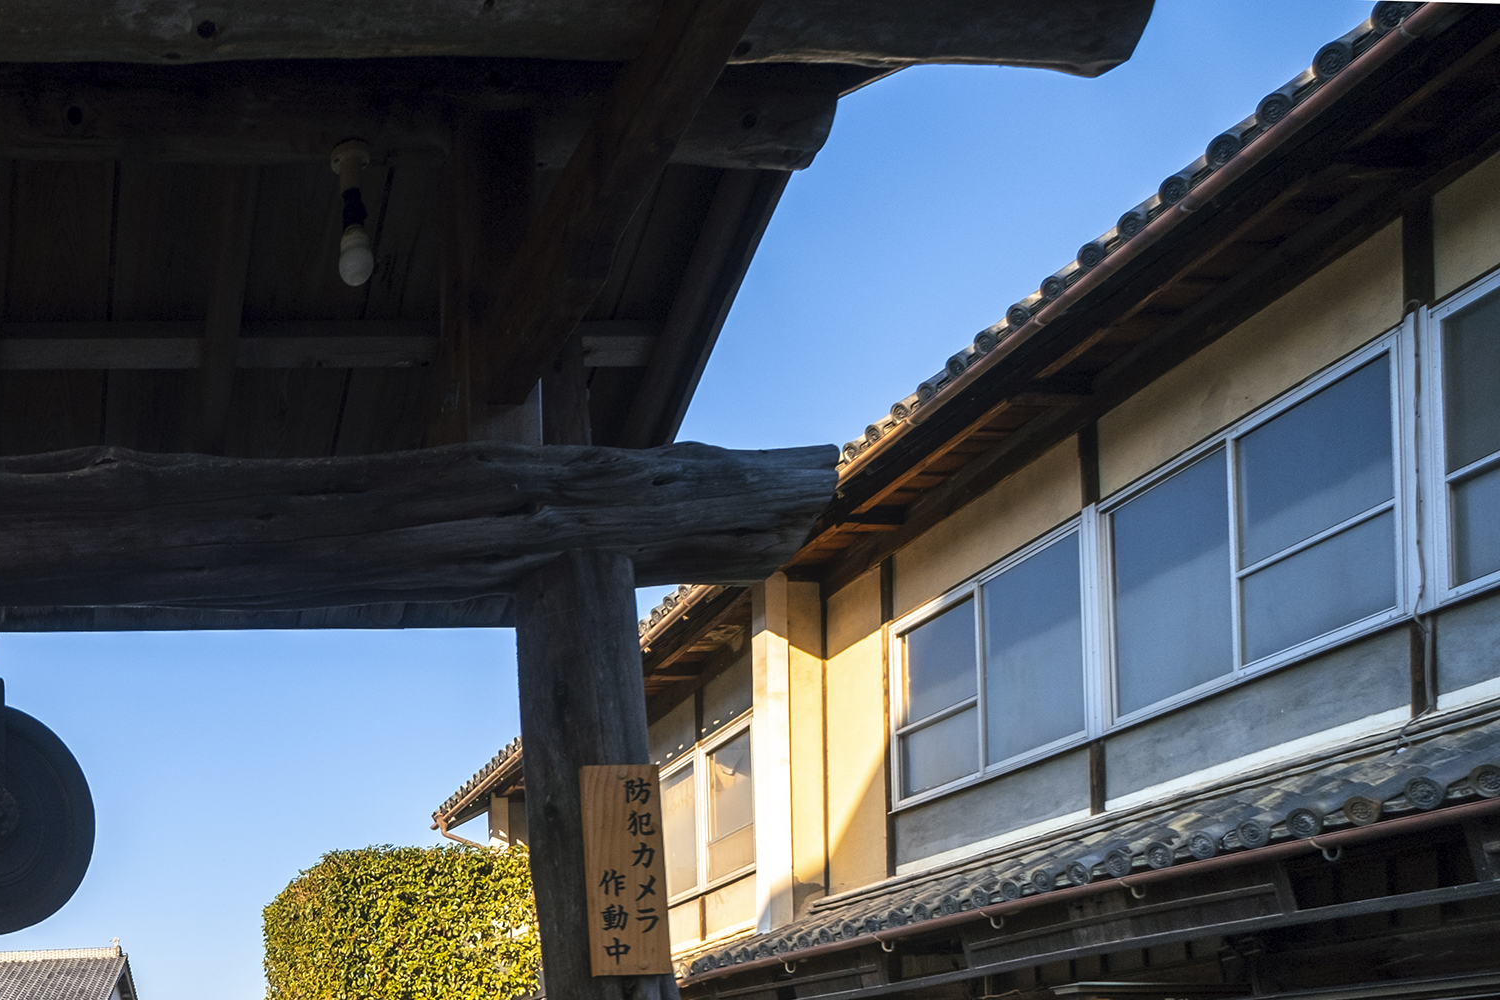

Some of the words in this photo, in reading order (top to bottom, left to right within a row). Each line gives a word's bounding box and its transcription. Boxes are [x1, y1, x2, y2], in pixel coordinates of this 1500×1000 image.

[598, 868, 631, 966] 作動中
[624, 777, 660, 934] 防犯カメラ
